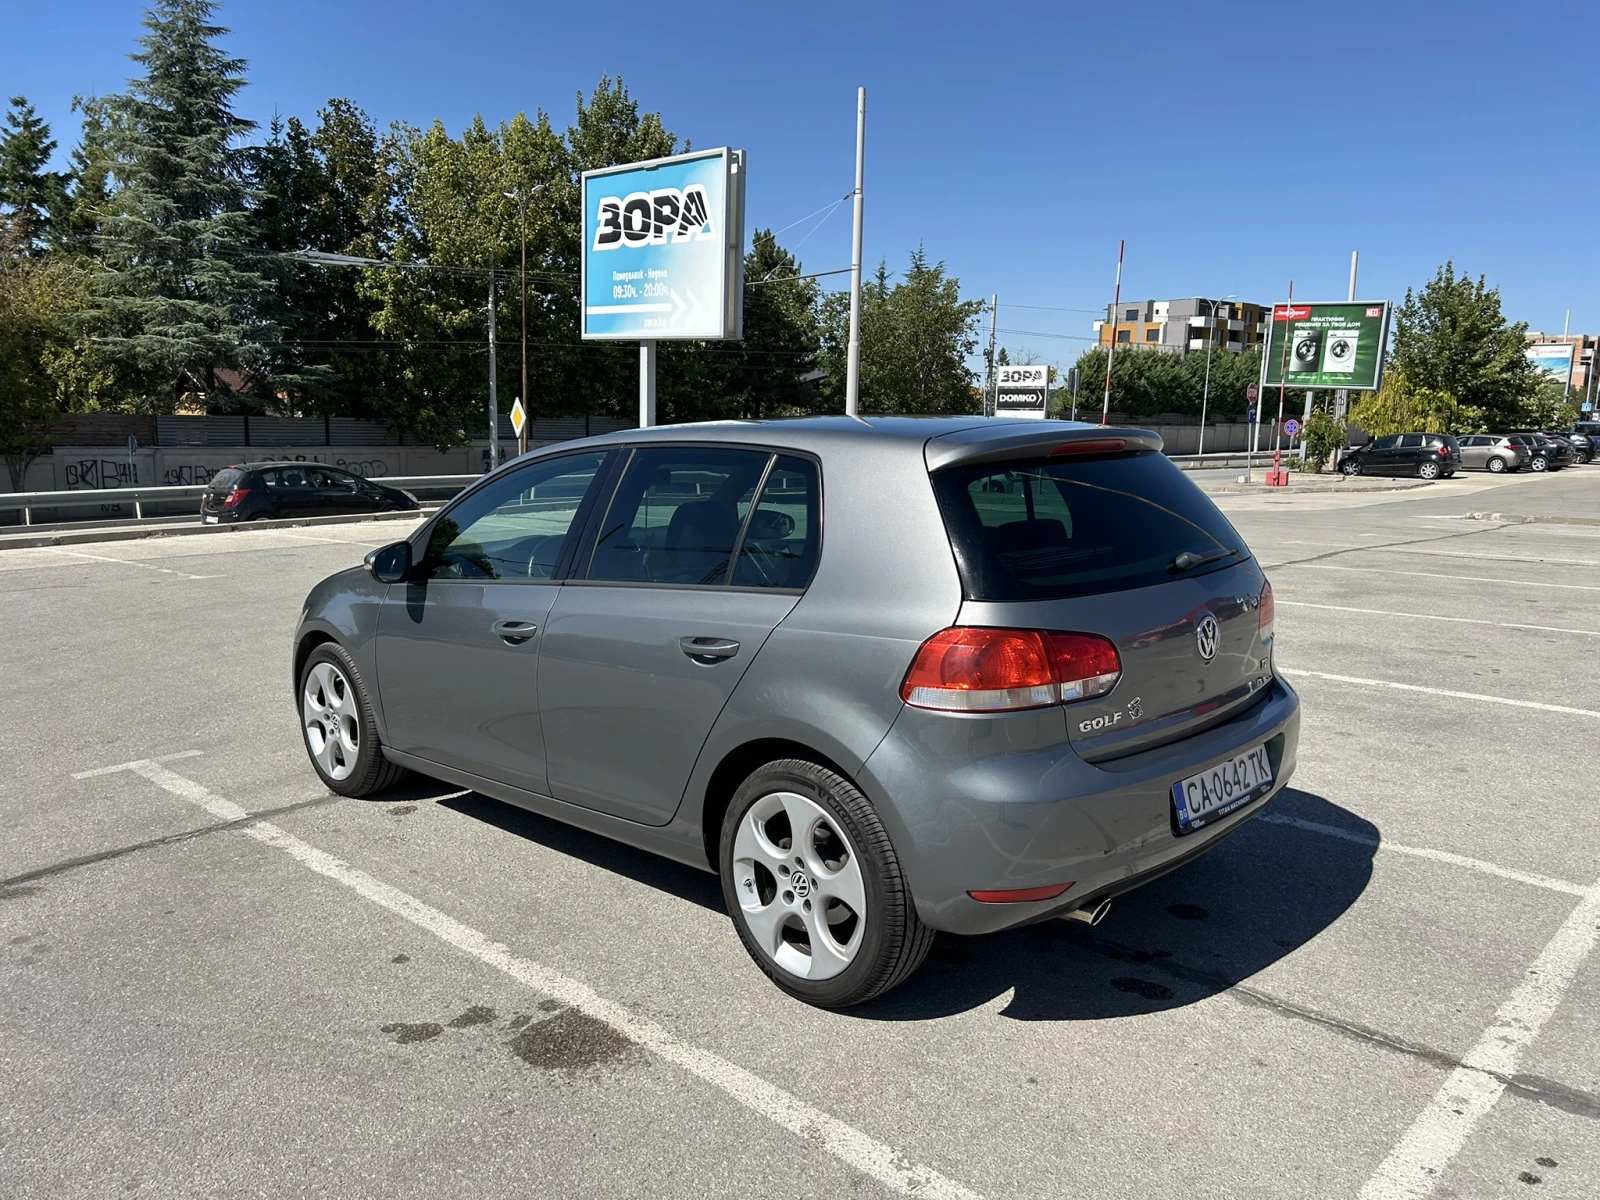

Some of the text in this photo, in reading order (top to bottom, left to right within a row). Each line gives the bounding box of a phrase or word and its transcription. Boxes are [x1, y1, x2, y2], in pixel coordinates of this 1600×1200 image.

[597, 190, 708, 245] ЗОРА
[999, 393, 1037, 403] DOMKO
[1078, 711, 1123, 733] GOLF
[1178, 807, 1189, 820] BG
[1218, 804, 1231, 816] TITAN
